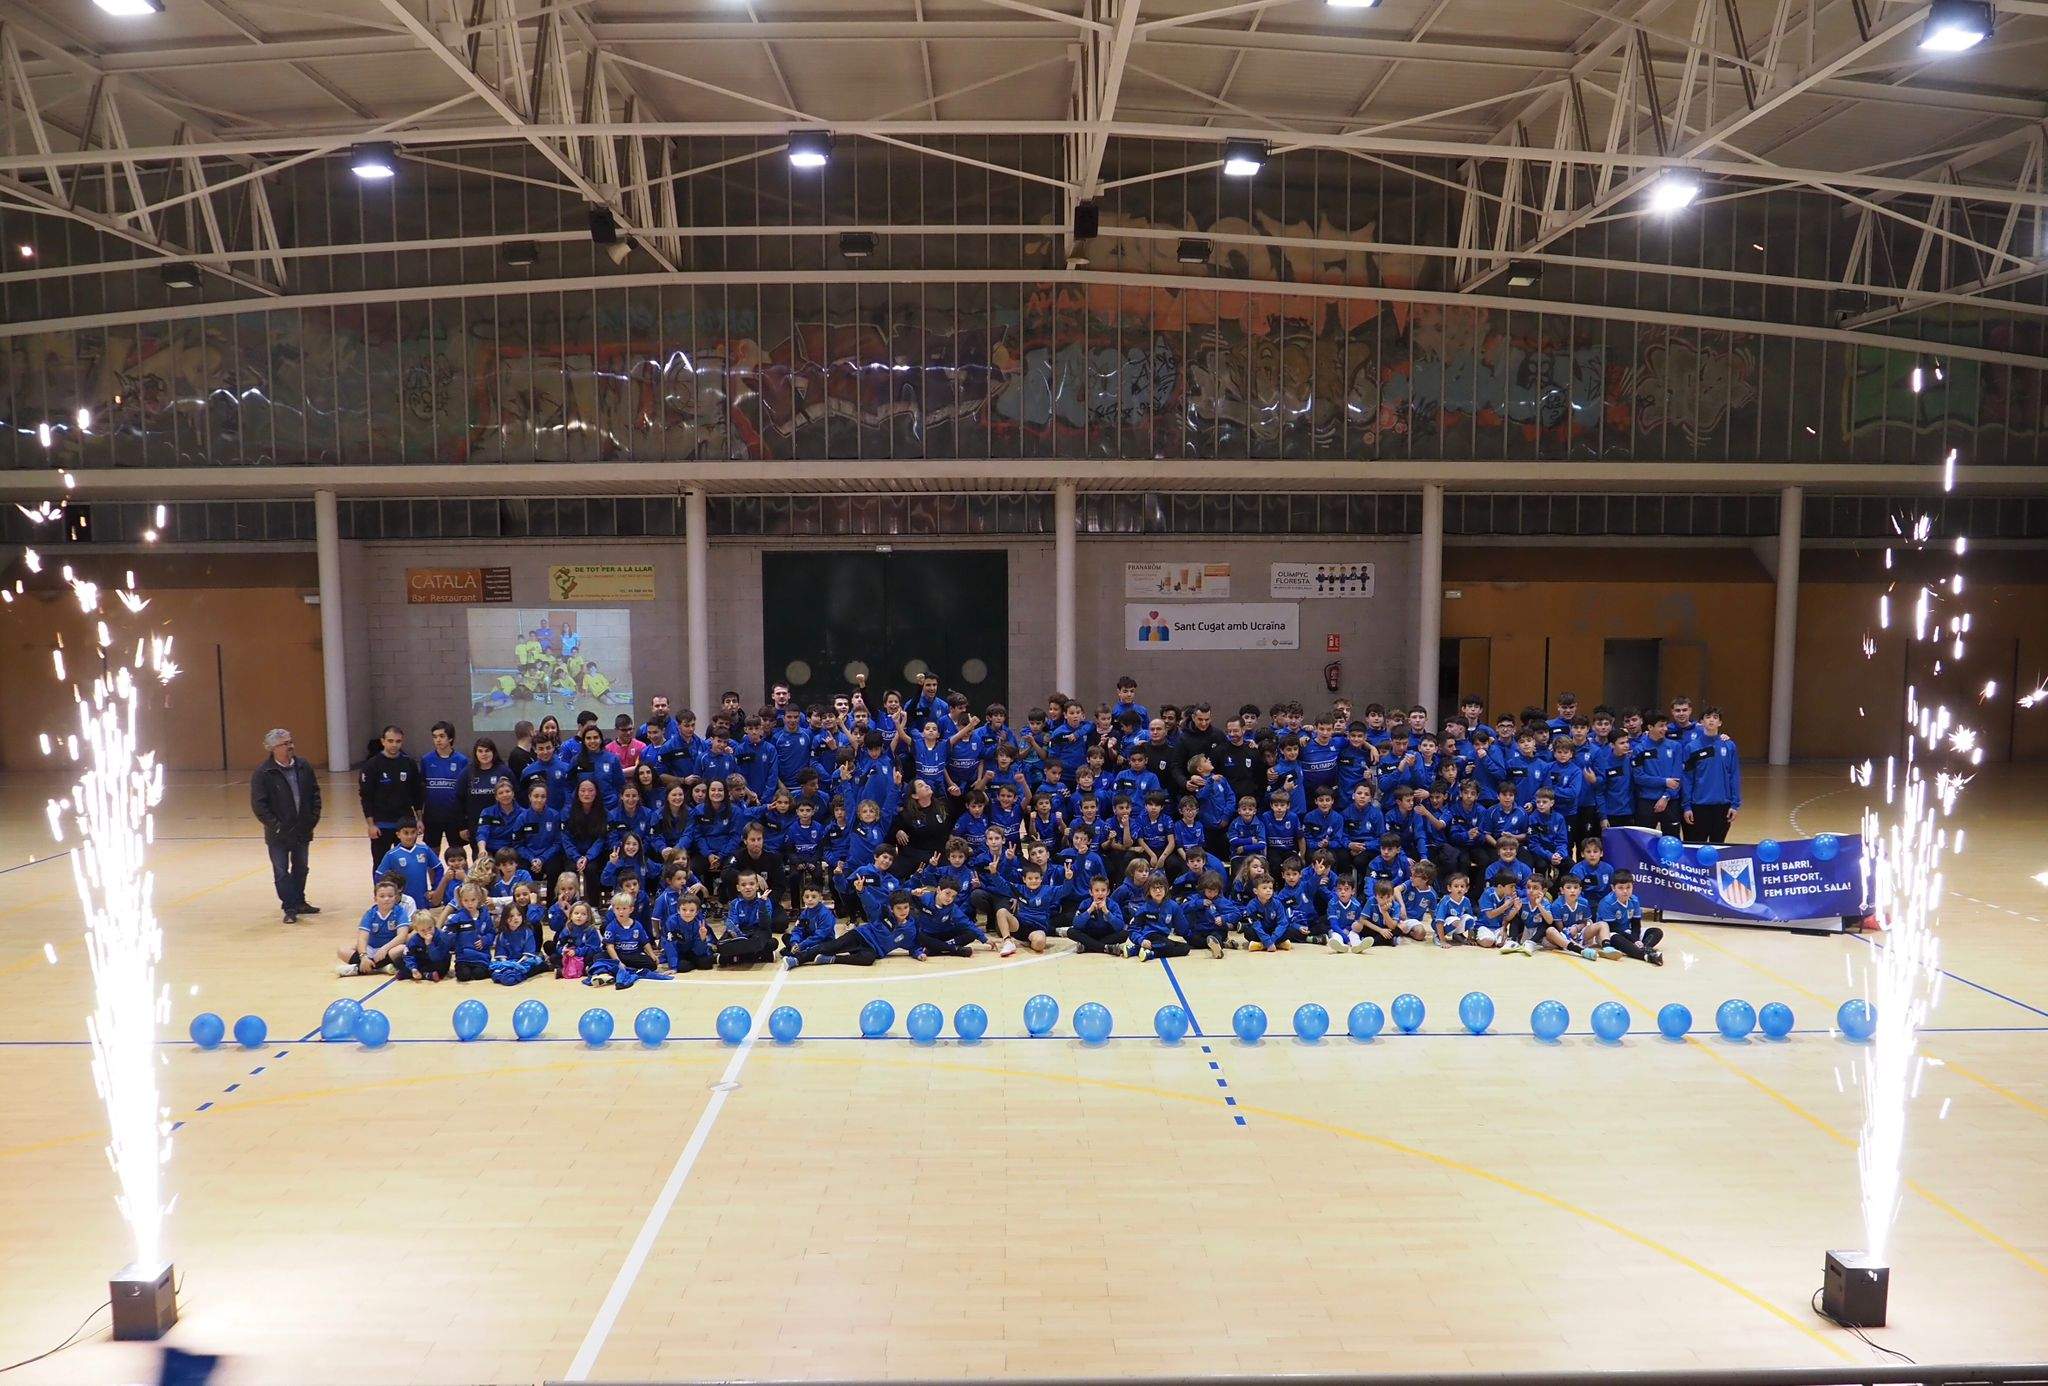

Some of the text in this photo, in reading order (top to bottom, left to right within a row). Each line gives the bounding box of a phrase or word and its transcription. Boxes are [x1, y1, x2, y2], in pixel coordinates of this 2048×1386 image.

[411, 571, 477, 589] CATALÀ
[412, 594, 426, 602] Bar
[430, 593, 477, 602] Restaurant
[1174, 621, 1286, 632] Sant Cugat amb Ucraïna
[1661, 858, 1710, 876] SOM EQUIP!
[1761, 863, 1780, 872] FEM
[1782, 860, 1813, 870] BARRI,
[1640, 862, 1712, 886] EL PROGRAMA DE
[1763, 872, 1823, 885] FEM ESPORT,
[1654, 877, 1666, 886] DE
[1668, 881, 1714, 896] L'OLIMPYC
[1764, 882, 1851, 897] FEM FUTBOL SALA!
